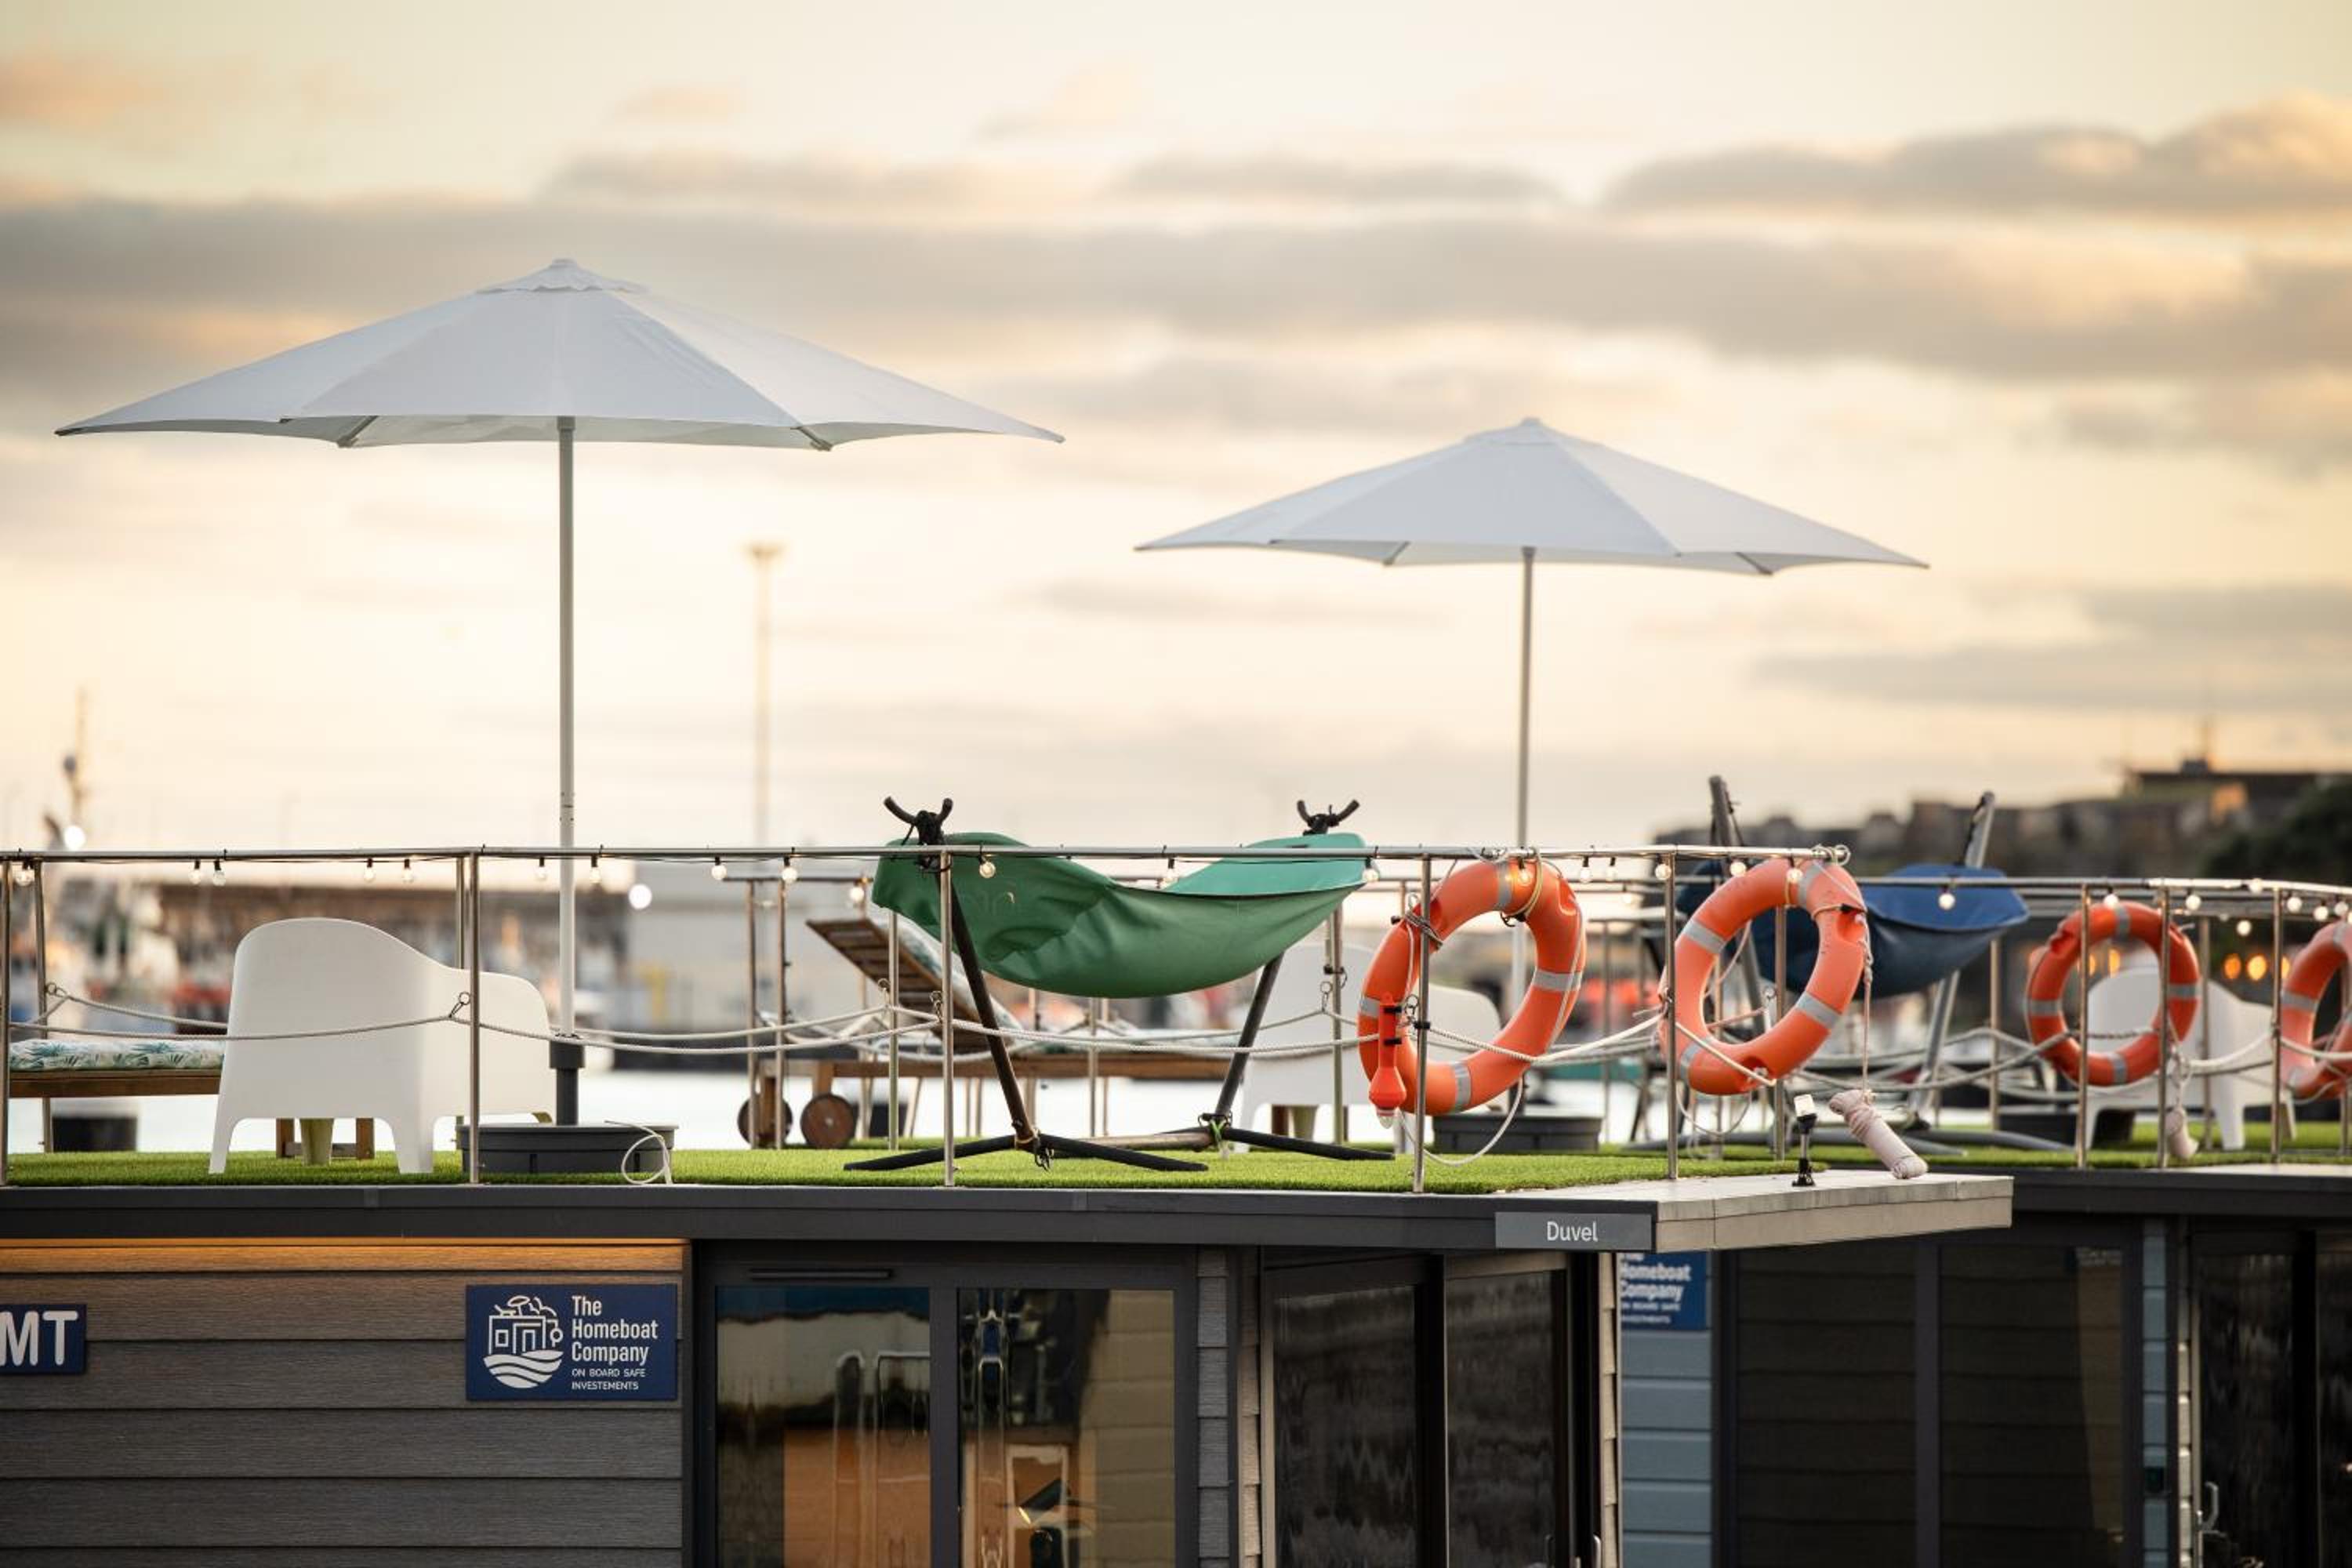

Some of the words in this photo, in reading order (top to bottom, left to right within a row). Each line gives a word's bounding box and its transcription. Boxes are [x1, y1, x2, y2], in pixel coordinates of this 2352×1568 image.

[1546, 1221, 1599, 1242] Duvel
[572, 1295, 601, 1316] The
[572, 1319, 659, 1340] Homeboat
[572, 1341, 649, 1367] Company
[572, 1368, 586, 1377] ON
[589, 1368, 620, 1377] BOARD
[623, 1368, 646, 1377] SAFE
[572, 1381, 639, 1390] INVESTEMENTS
